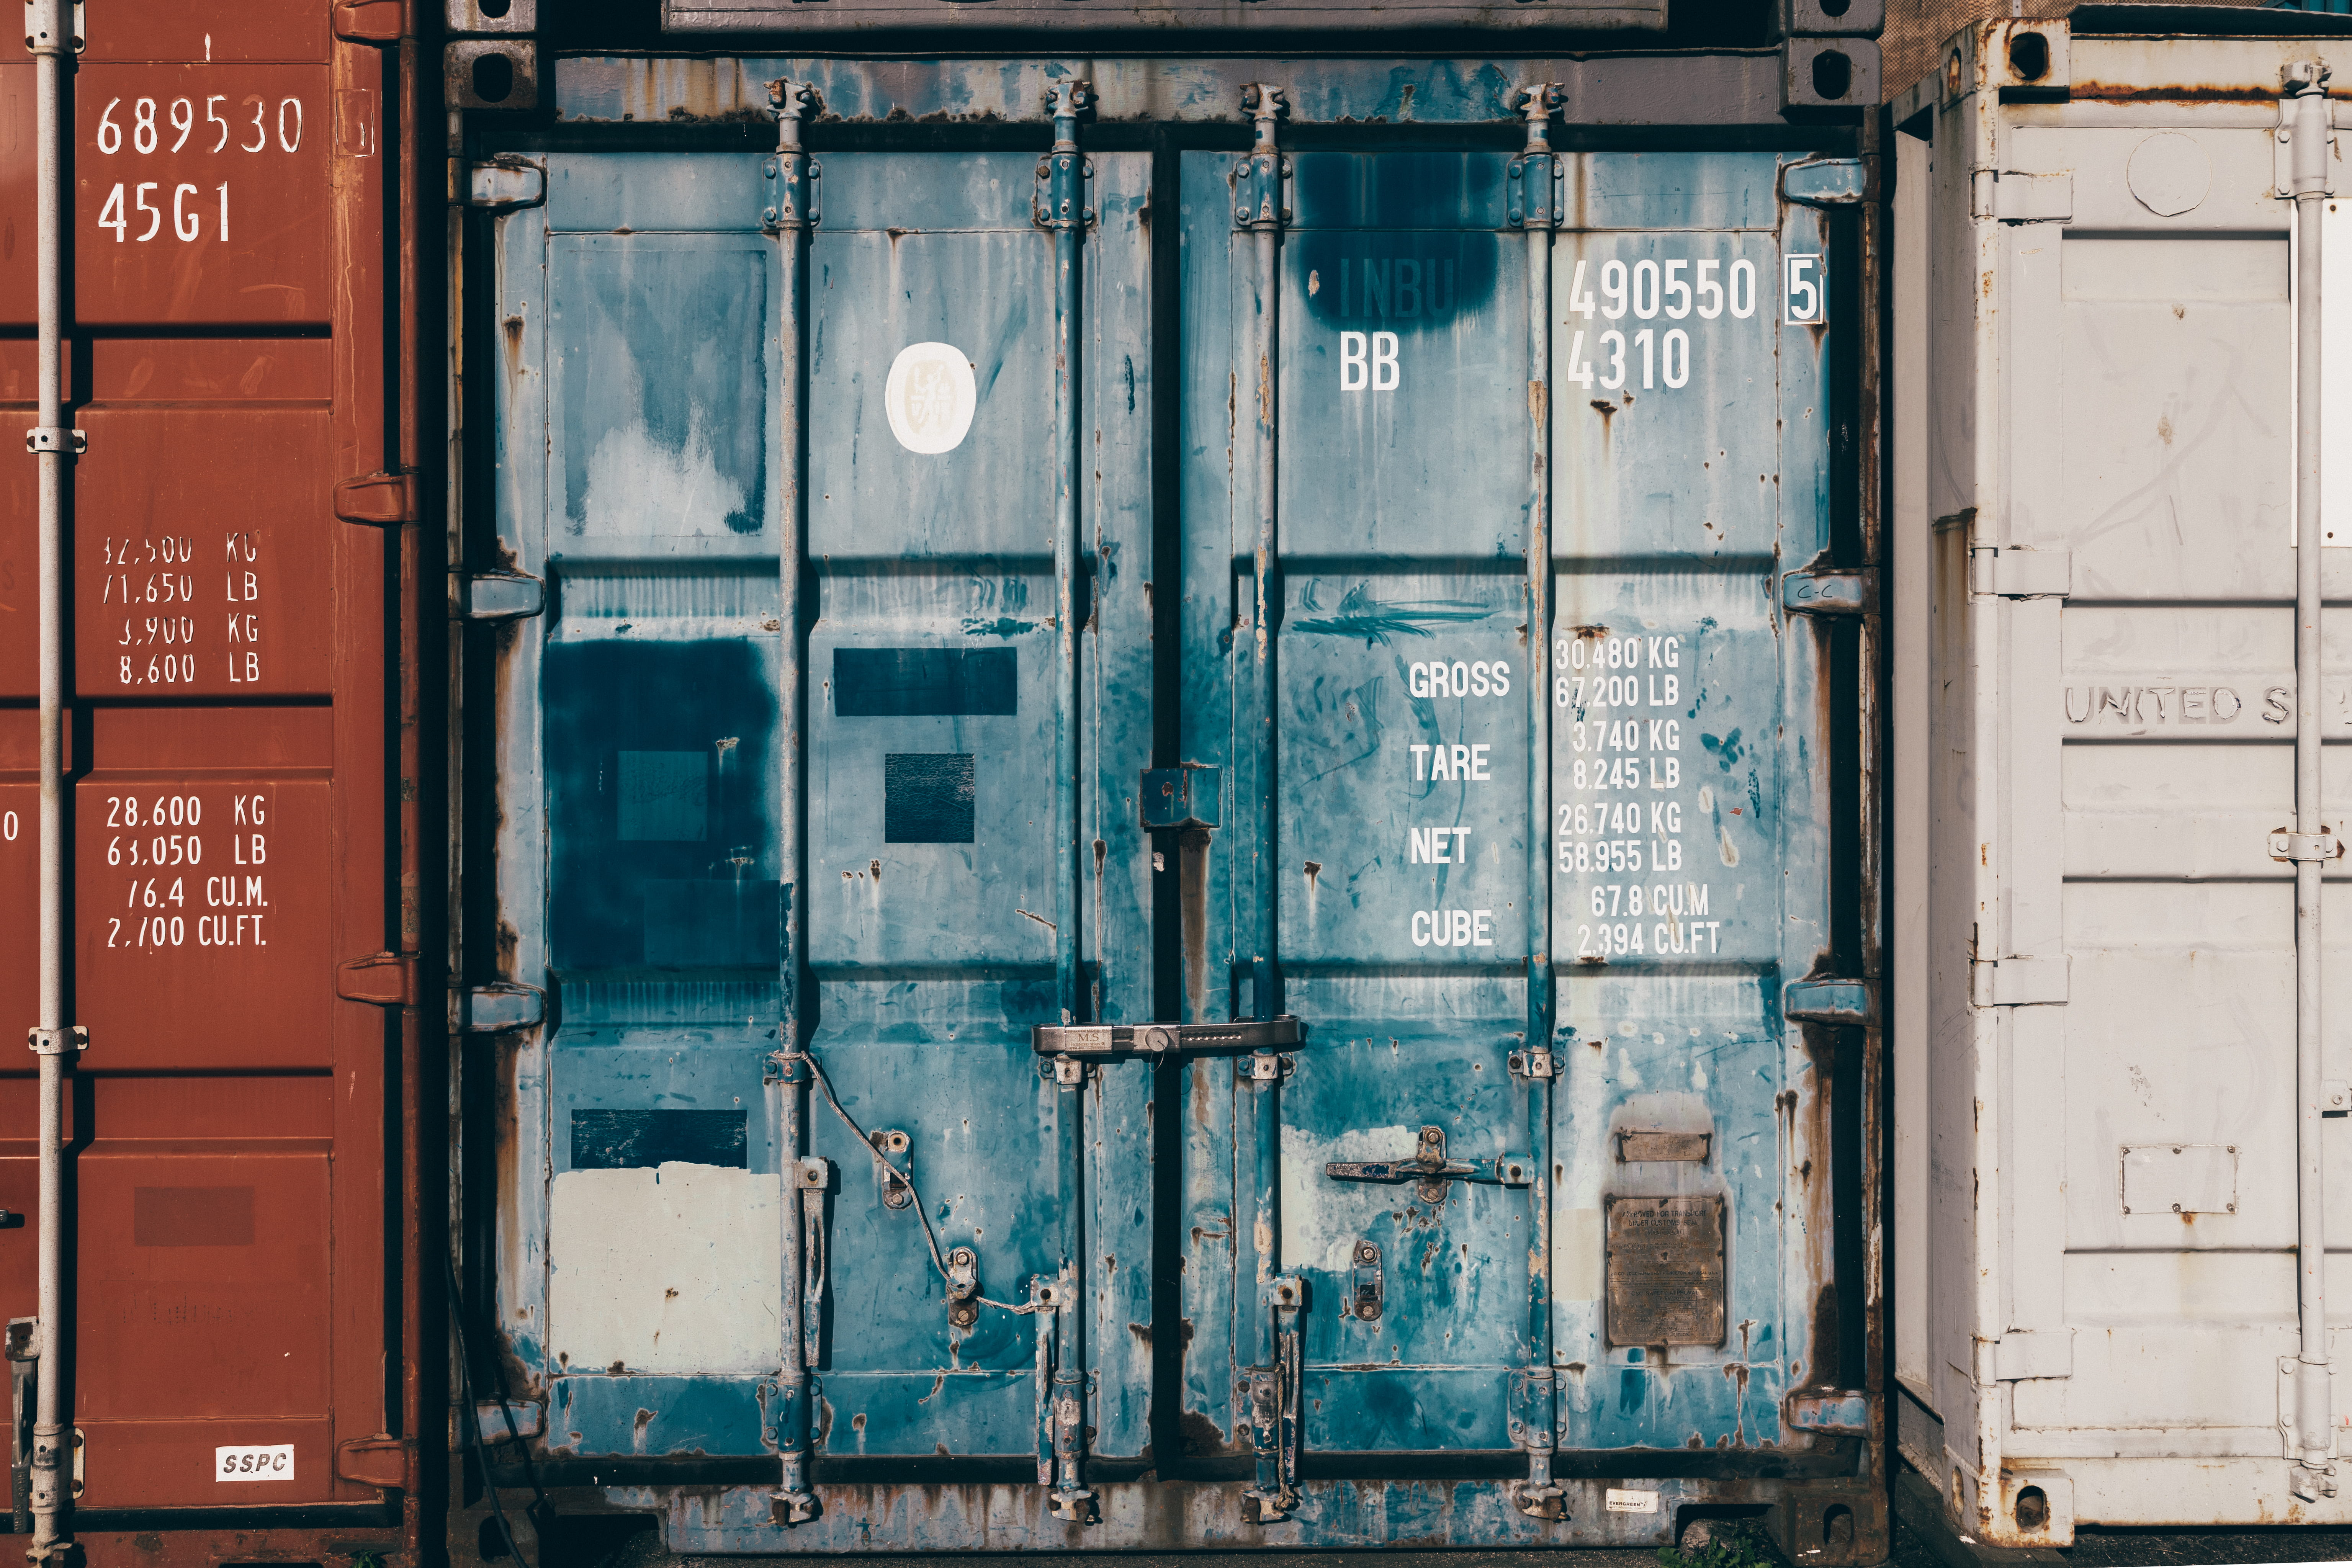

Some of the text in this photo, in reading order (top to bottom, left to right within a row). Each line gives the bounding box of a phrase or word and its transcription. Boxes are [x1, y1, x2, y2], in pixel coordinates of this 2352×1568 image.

[98, 95, 303, 154] 689530
[98, 181, 229, 242] 45G1
[1340, 258, 1454, 318] INBU
[1570, 259, 1817, 319] 490550 5
[1341, 332, 1400, 391] BB
[1568, 329, 1689, 390] 4310
[227, 571, 258, 602] LB
[229, 613, 258, 643] KG
[120, 652, 259, 684] 8,600 LB
[1555, 636, 1678, 669] 30,480 KG
[1410, 661, 1510, 698] GROSS
[1556, 674, 1679, 707] 67,200 LB
[2066, 687, 2241, 724] UNITED
[1573, 719, 1679, 752] 3,740 KG
[1410, 744, 1490, 781] TARE
[1573, 757, 1680, 790] 8,245 LB
[107, 795, 265, 827] 28,600 KG
[1559, 801, 1681, 835] 26,740 KG
[108, 834, 266, 866] 63,050 LB
[1411, 827, 1471, 864] NET
[1559, 839, 1681, 873] 58,955 LB
[207, 876, 268, 906] CU.M.
[1591, 884, 1708, 917] 67.8 CU.M
[198, 914, 267, 946] CU.FT.
[1412, 909, 1492, 947] CUBE
[1577, 921, 1720, 955] 2,394 CU.FT
[223, 1453, 286, 1473] SSPC
